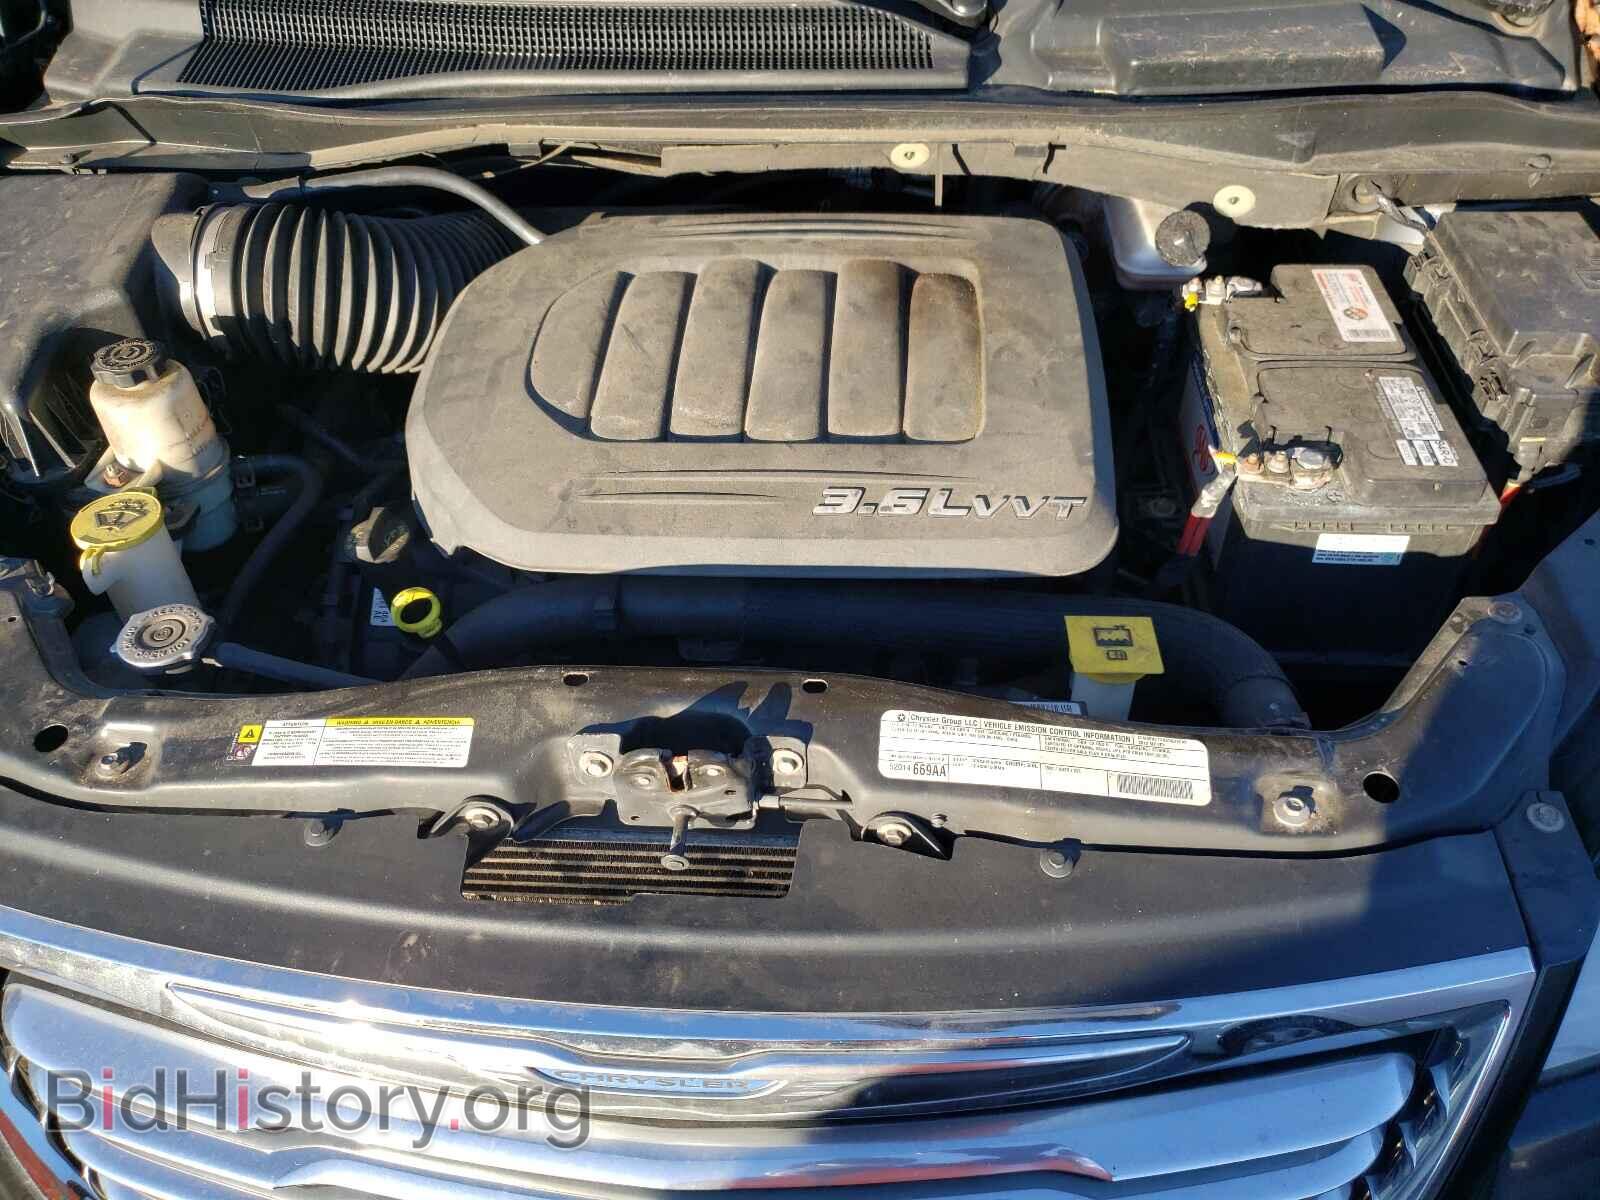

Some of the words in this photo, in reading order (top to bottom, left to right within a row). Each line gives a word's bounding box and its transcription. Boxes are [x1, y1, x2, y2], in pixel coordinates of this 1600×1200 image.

[910, 713, 939, 723] Chrysler
[941, 716, 962, 727] Group
[964, 719, 979, 728] LLC
[983, 720, 1012, 730] VEHICLE
[1014, 723, 1047, 735] EMISSION
[1049, 727, 1081, 738] CONTROL
[1083, 731, 1131, 743] INFORMATION
[913, 763, 946, 777] 669AA
[553, 1070, 749, 1090] CHRYSLER
